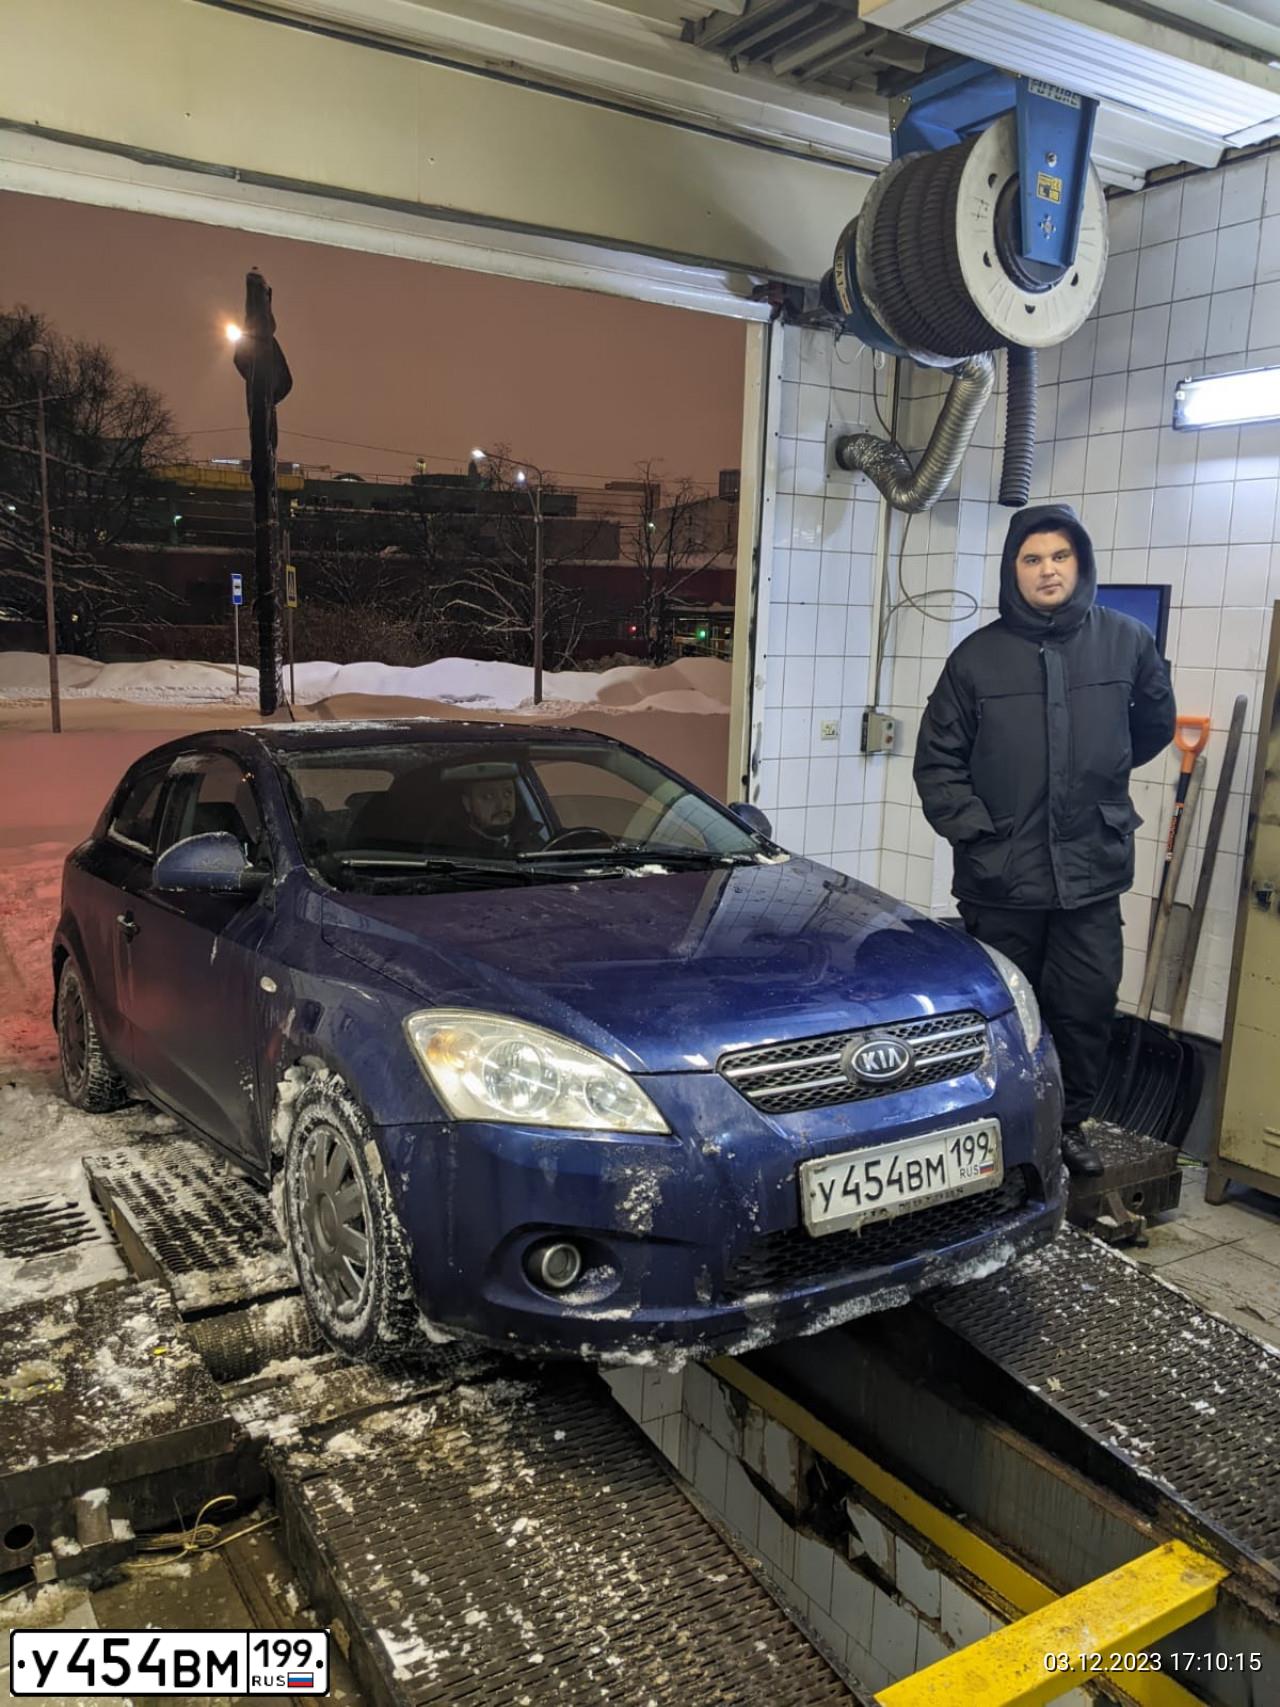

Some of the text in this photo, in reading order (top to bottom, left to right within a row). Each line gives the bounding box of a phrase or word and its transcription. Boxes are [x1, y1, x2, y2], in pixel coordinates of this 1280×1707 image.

[861, 1047, 902, 1071] KIA
[818, 1154, 945, 1212] У454ВМ
[950, 1131, 989, 1167] 199
[959, 1167, 979, 1179] RUS
